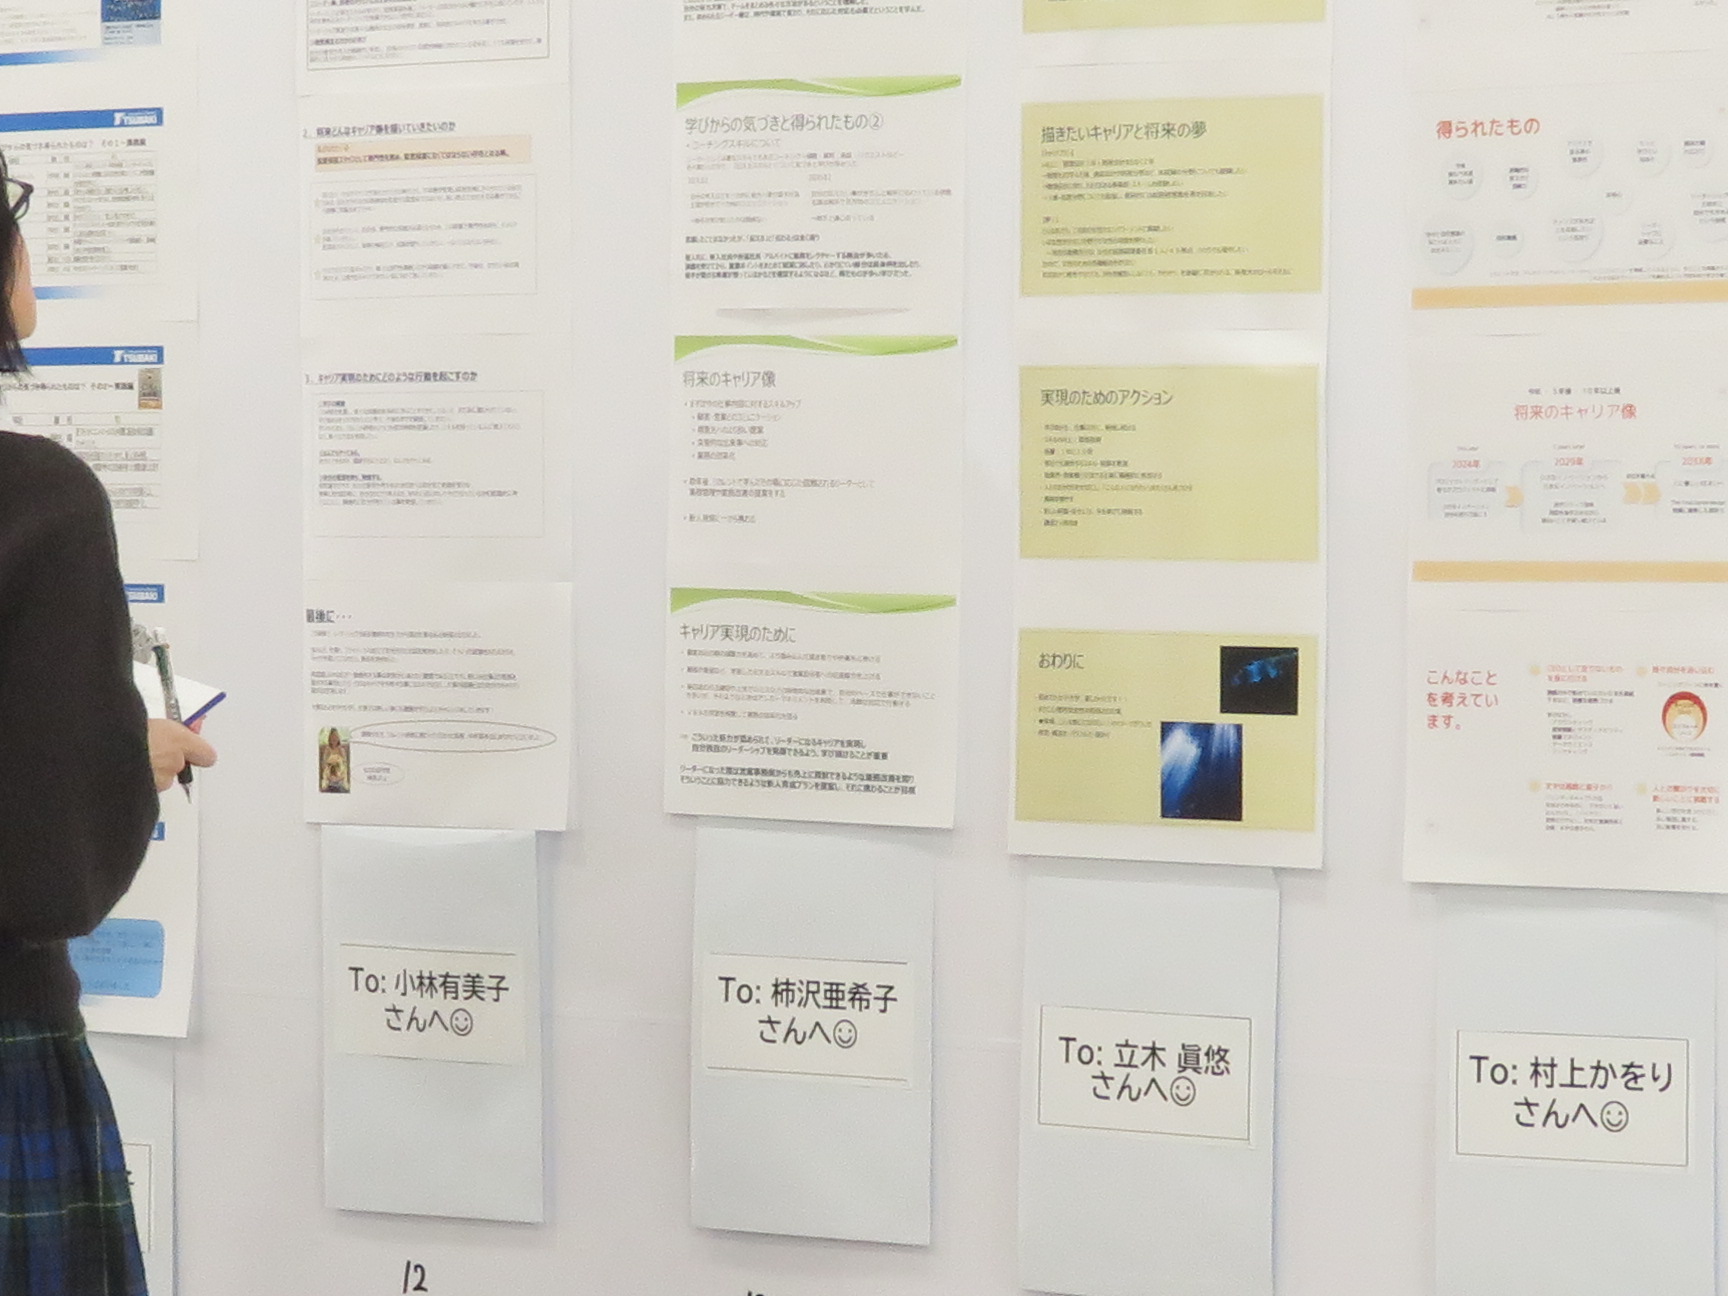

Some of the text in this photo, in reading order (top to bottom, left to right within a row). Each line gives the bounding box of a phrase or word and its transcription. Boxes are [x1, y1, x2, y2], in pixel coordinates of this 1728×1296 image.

[685, 114, 885, 134] 学びからの気づきと得られたもの②
[1041, 121, 1207, 144] 描きたいキャリアと将来の夢
[1436, 118, 1541, 140] 得られたもの
[683, 371, 776, 388] 将来のキャリア像
[1041, 388, 1174, 407] 実現のためのアクション
[1514, 403, 1638, 421] 将来のキャリア像
[680, 624, 797, 643] キャリア実現のために
[1038, 652, 1085, 670] おわりに
[1426, 669, 1498, 686] こんなこと
[1426, 692, 1500, 708] を考えてい
[1426, 714, 1462, 731] ます。
[347, 967, 510, 1004] To: 小林有美子
[718, 977, 898, 1015] To: 柿沢亜希子
[383, 1004, 449, 1034] さんへ
[758, 1015, 831, 1046] さんへ
[1058, 1036, 1231, 1078] To: 立木 眞悠
[1469, 1055, 1674, 1093] To: 村上かをり
[1091, 1072, 1170, 1104] さんへ
[1513, 1097, 1598, 1131] さんへ
[402, 1259, 429, 1295] 12
